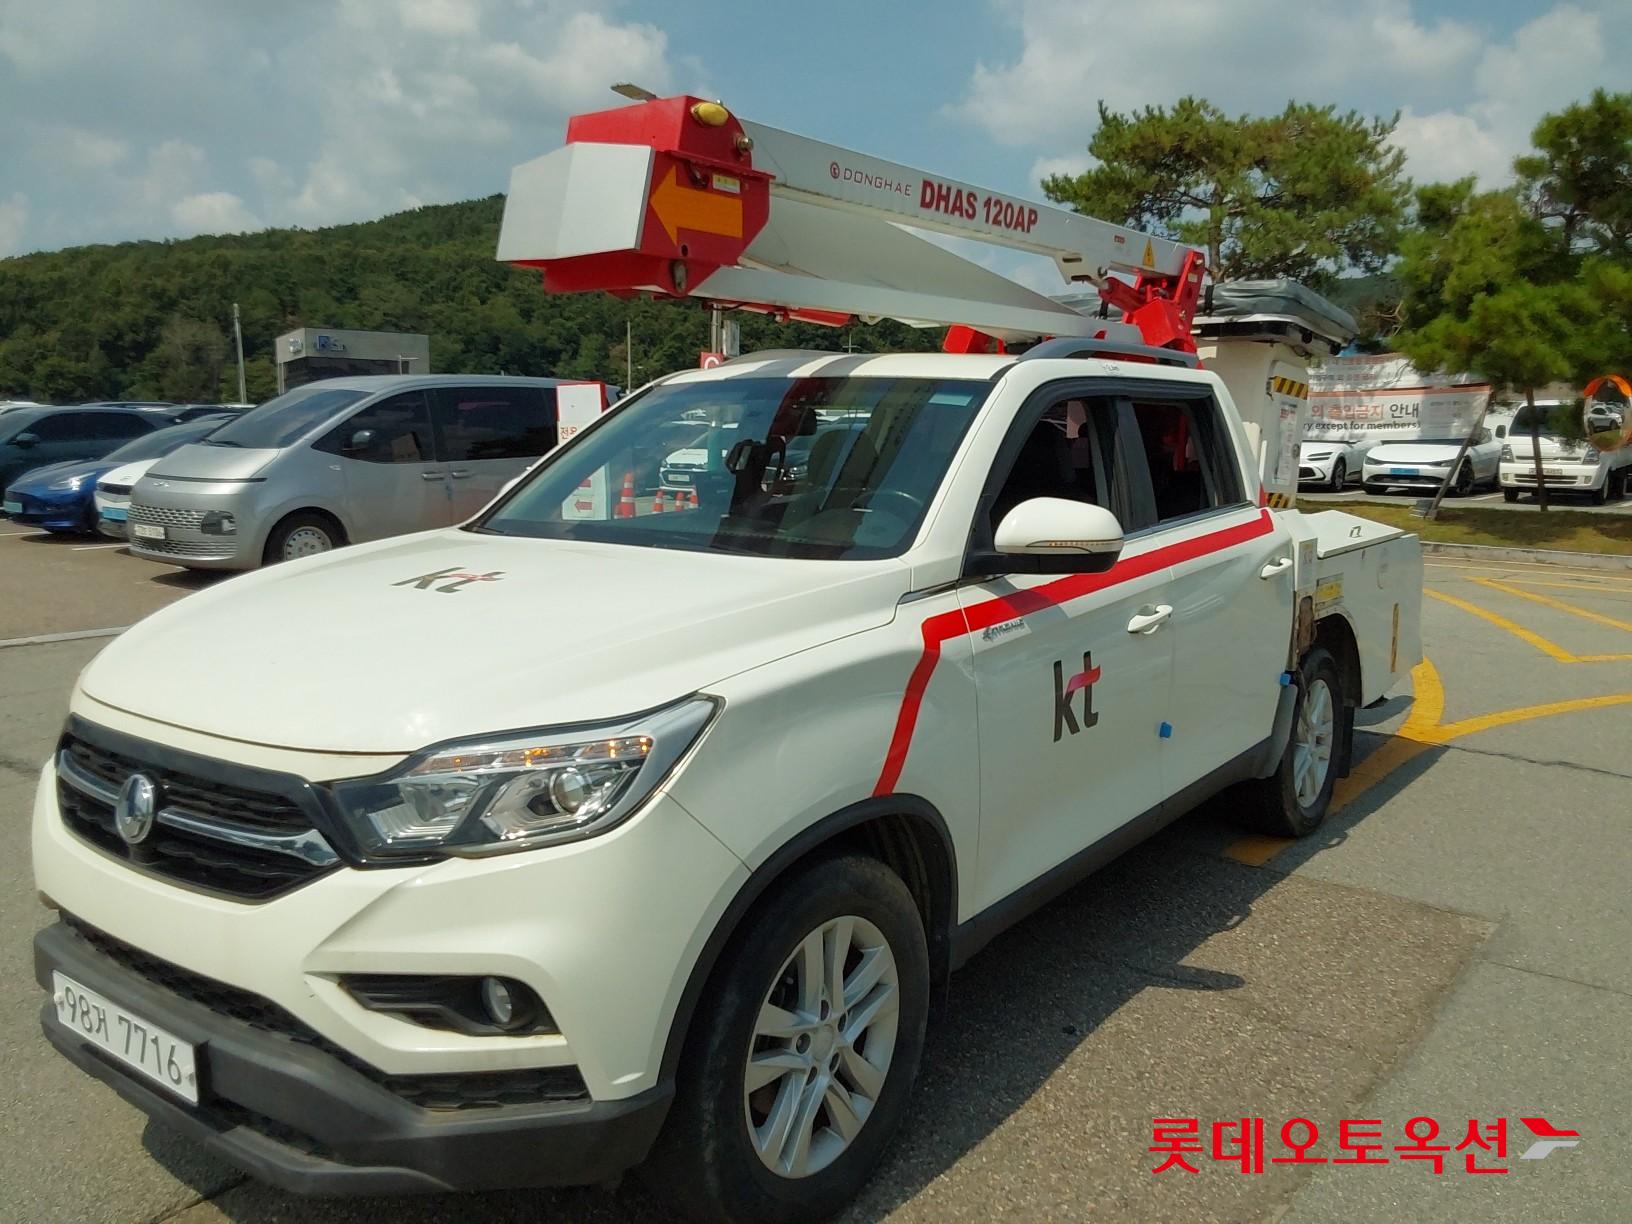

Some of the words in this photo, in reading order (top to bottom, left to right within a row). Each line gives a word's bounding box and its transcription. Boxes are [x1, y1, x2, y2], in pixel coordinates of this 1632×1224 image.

[844, 167, 912, 197] DONGHAE
[920, 179, 978, 221] DHAS
[983, 196, 1038, 233] 120AP
[1315, 421, 1348, 431] except
[1350, 420, 1365, 430] for
[1328, 403, 1385, 420] 출입금지
[1389, 403, 1419, 419] 안내
[392, 567, 506, 593] kt
[1053, 650, 1101, 743] kt
[118, 1013, 182, 1085] 7716
